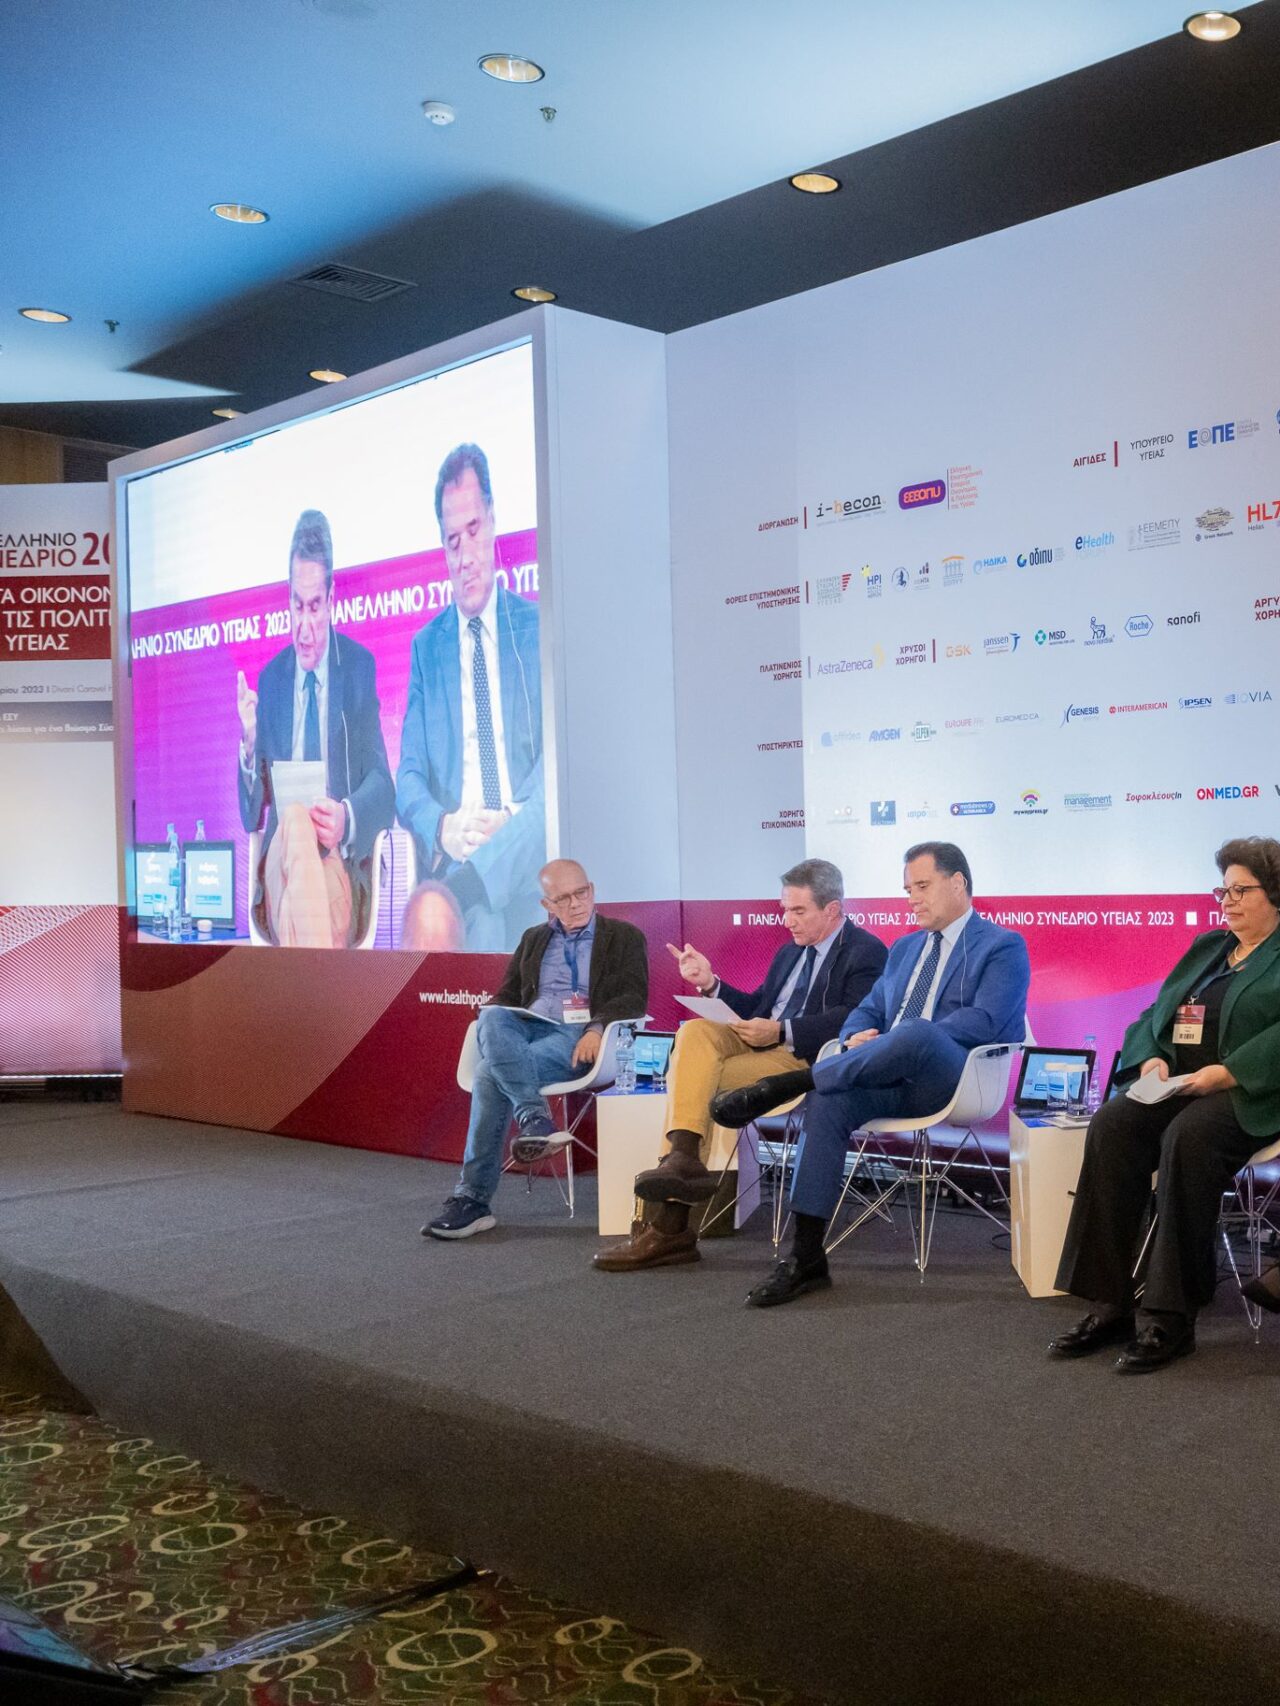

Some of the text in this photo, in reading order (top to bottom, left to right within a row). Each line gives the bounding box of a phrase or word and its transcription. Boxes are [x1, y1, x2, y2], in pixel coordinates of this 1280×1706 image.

[1130, 433, 1174, 451] ΥΠΟΥΡΓΕΙΟ
[1073, 452, 1107, 467] ΑΙΓΙΔΕΣ
[1139, 448, 1165, 461] ΥΓΕΙΑΣ
[758, 516, 799, 532] ΔΙΟΡΓΑΝΩΣΗ
[1075, 531, 1115, 550] eHealth
[0, 548, 76, 568] ΕΔΡΙΟ
[725, 594, 749, 606] ΦΟΡΕΙΣ
[2, 610, 34, 628] ΤΙΣ
[1167, 612, 1201, 626] sanofi
[165, 622, 220, 655] ΣΥΝΕΔΡΙΟ
[264, 609, 292, 638] 2023
[1048, 630, 1066, 641] MSD
[5, 633, 70, 650] ΥΓΕΙΑΣ
[899, 643, 926, 655] ΧΡΥΣΟΙ
[817, 658, 873, 676] AstraZeneca
[895, 654, 926, 666] ΧΟΡΗΓΟΙ
[773, 671, 802, 681] ΧΟΡΗΓΟΣ
[1117, 702, 1168, 714] INTERAMERICAN
[1184, 697, 1212, 706] IPSEN
[1071, 706, 1099, 717] GENESIS
[1196, 786, 1259, 801] ONMED.GR
[868, 912, 901, 925] ΥΓΕΙΑΣ
[978, 911, 1174, 926] ΕΛΛΗΝΙΟ ΣΥΝΕΔΡΙΟ ΥΓΕΙΑΣ 2023
[420, 989, 494, 1009] www.healthpolic
